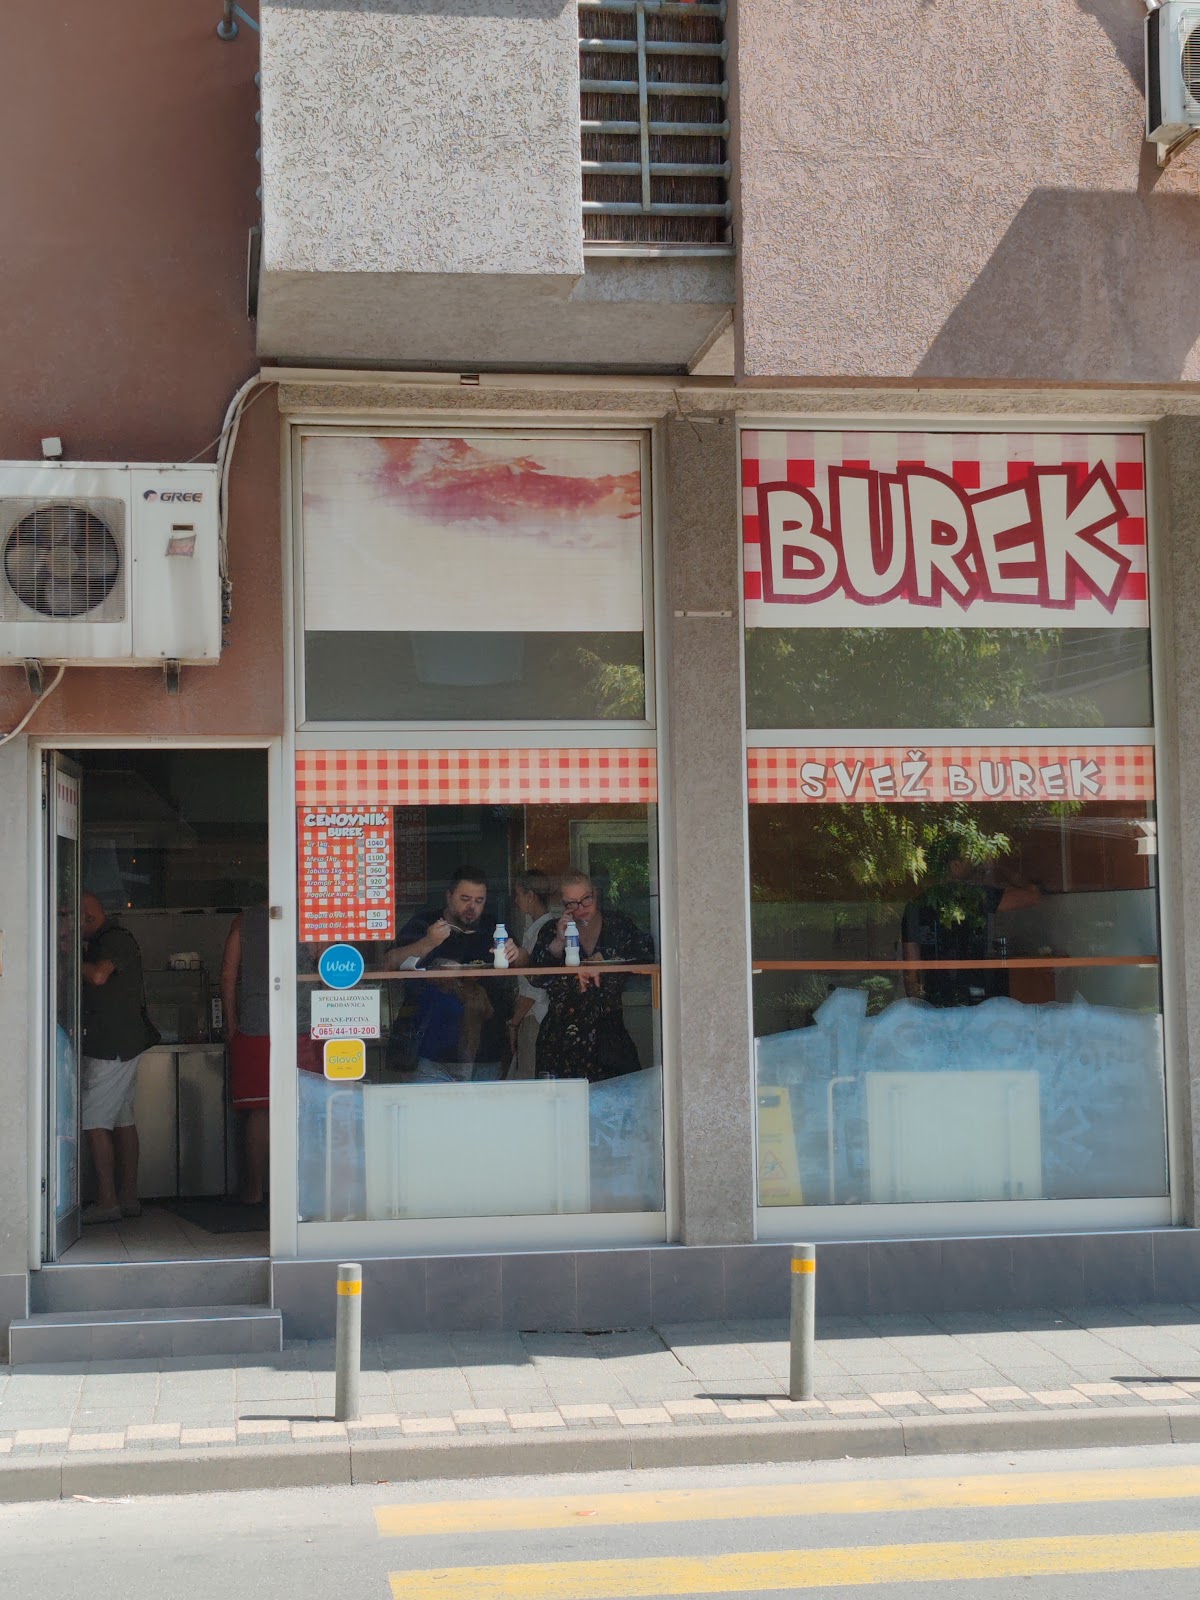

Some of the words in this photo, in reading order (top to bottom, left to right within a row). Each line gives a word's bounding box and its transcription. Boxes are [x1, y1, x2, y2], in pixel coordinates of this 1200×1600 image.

[160, 492, 203, 502] GREE
[756, 458, 1131, 615] BUREK
[799, 749, 932, 799] SVEŽ
[946, 758, 1103, 798] BUREK
[304, 812, 387, 827] CENOVNIK
[327, 827, 364, 838] BUREK
[326, 960, 357, 972] Wolt
[318, 1026, 376, 1036] 065/44-10-200
[328, 1055, 358, 1064] Glovo
